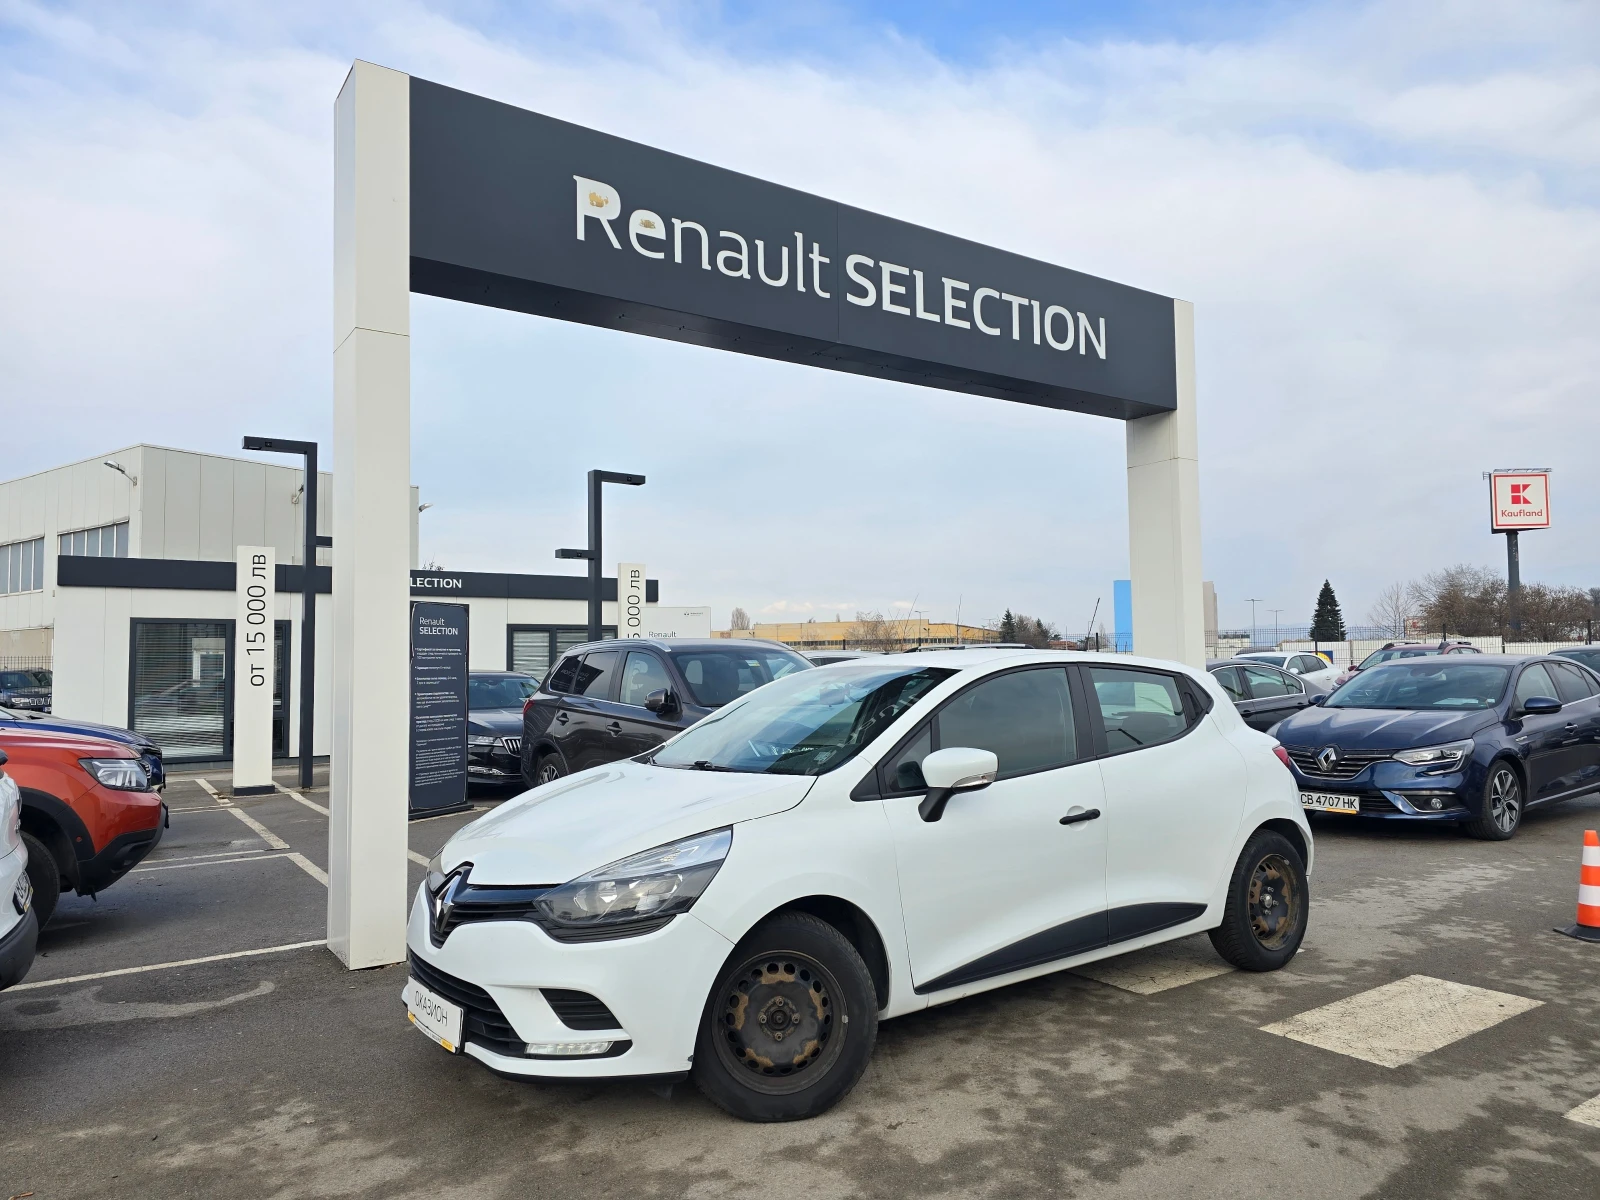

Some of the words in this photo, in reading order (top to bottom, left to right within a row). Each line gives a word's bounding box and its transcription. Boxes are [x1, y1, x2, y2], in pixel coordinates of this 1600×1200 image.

[573, 174, 831, 298] Renault
[845, 254, 1107, 359] SELECTION
[1501, 509, 1543, 517] Kaufland
[247, 585, 266, 625] 000
[627, 594, 640, 627] 000
[419, 616, 445, 626] Renault
[419, 626, 459, 635] SELECTION
[246, 632, 265, 655] 15
[1315, 795, 1341, 807] 4707
[414, 990, 448, 1027] ОКАЗИОН
